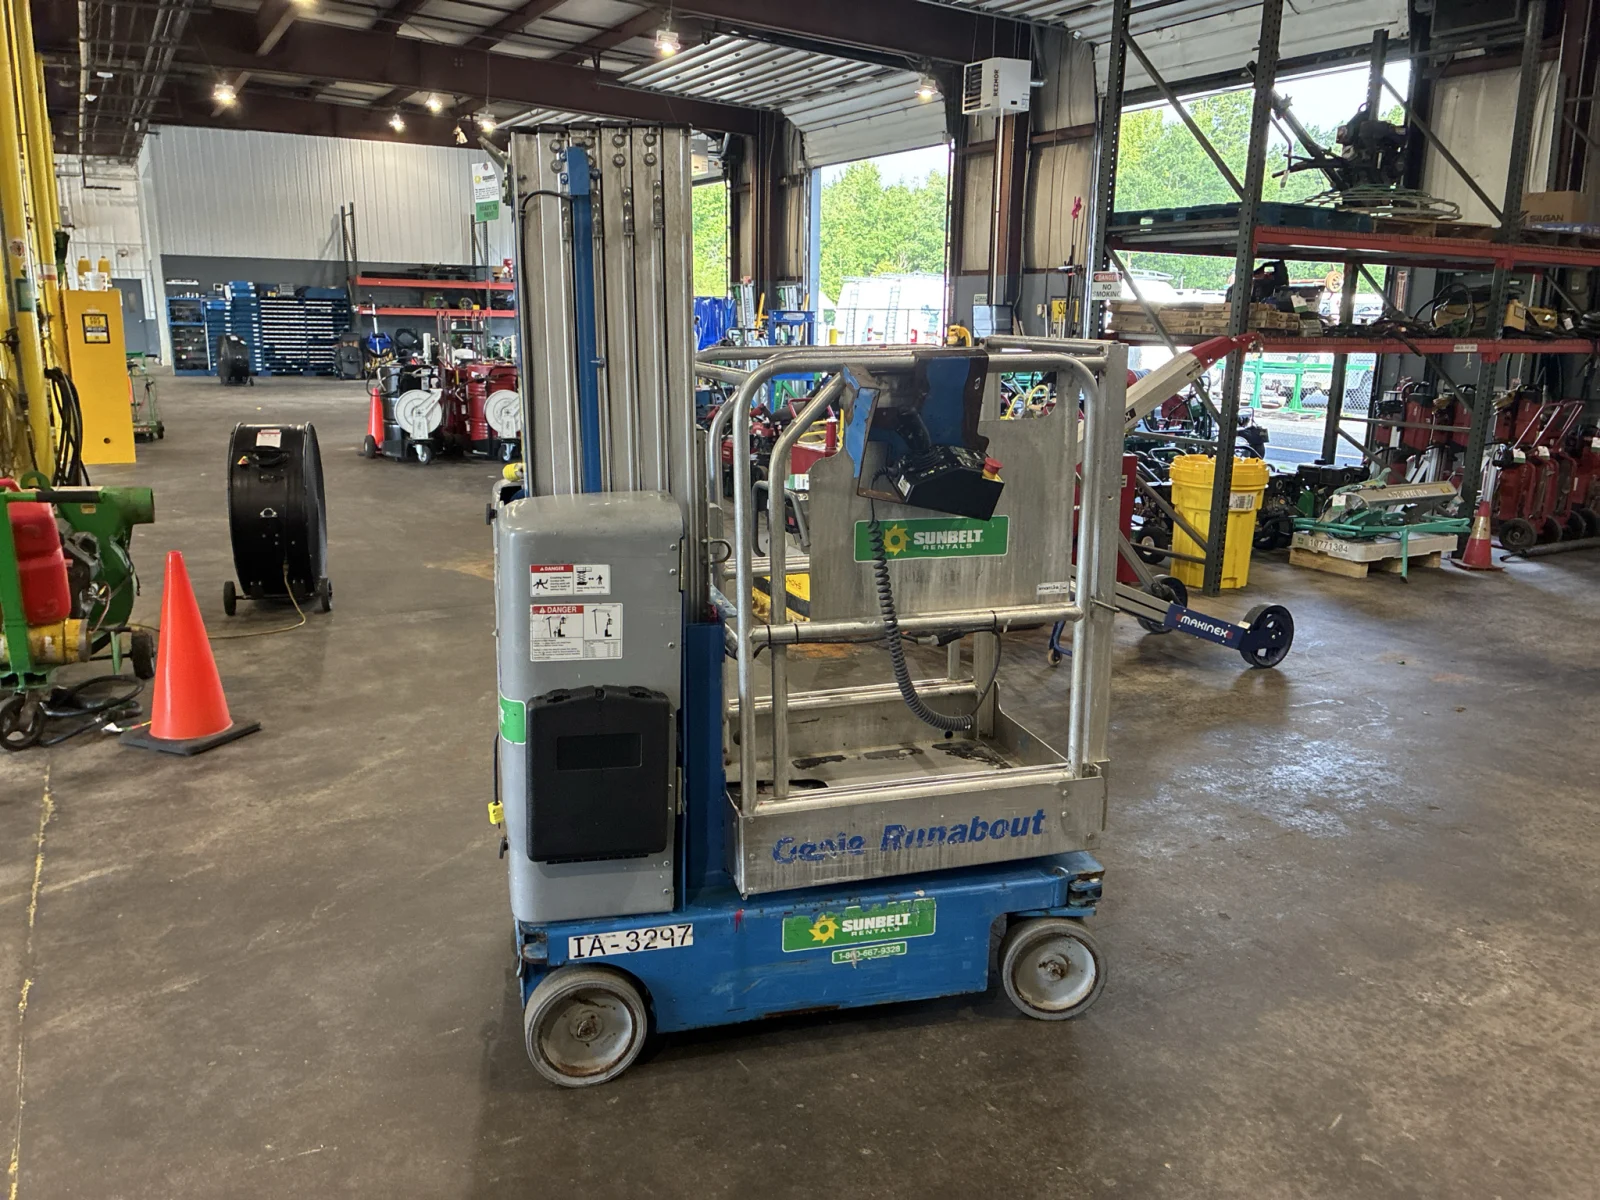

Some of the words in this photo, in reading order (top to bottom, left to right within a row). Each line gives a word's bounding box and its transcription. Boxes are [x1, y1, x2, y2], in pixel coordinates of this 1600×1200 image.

[1530, 214, 1565, 222] SILGAN
[914, 529, 984, 545] SUNBELT
[923, 543, 973, 551] RENTALS
[547, 606, 577, 614] DANGER
[1180, 615, 1229, 638] MAKINEX
[879, 808, 1047, 852] Runabout
[772, 832, 866, 864] Genie
[842, 913, 911, 932] SUNBELT
[851, 927, 900, 937] RENTALS
[573, 924, 692, 958] IA-3297
[838, 945, 901, 960] 1-80-667-9328
